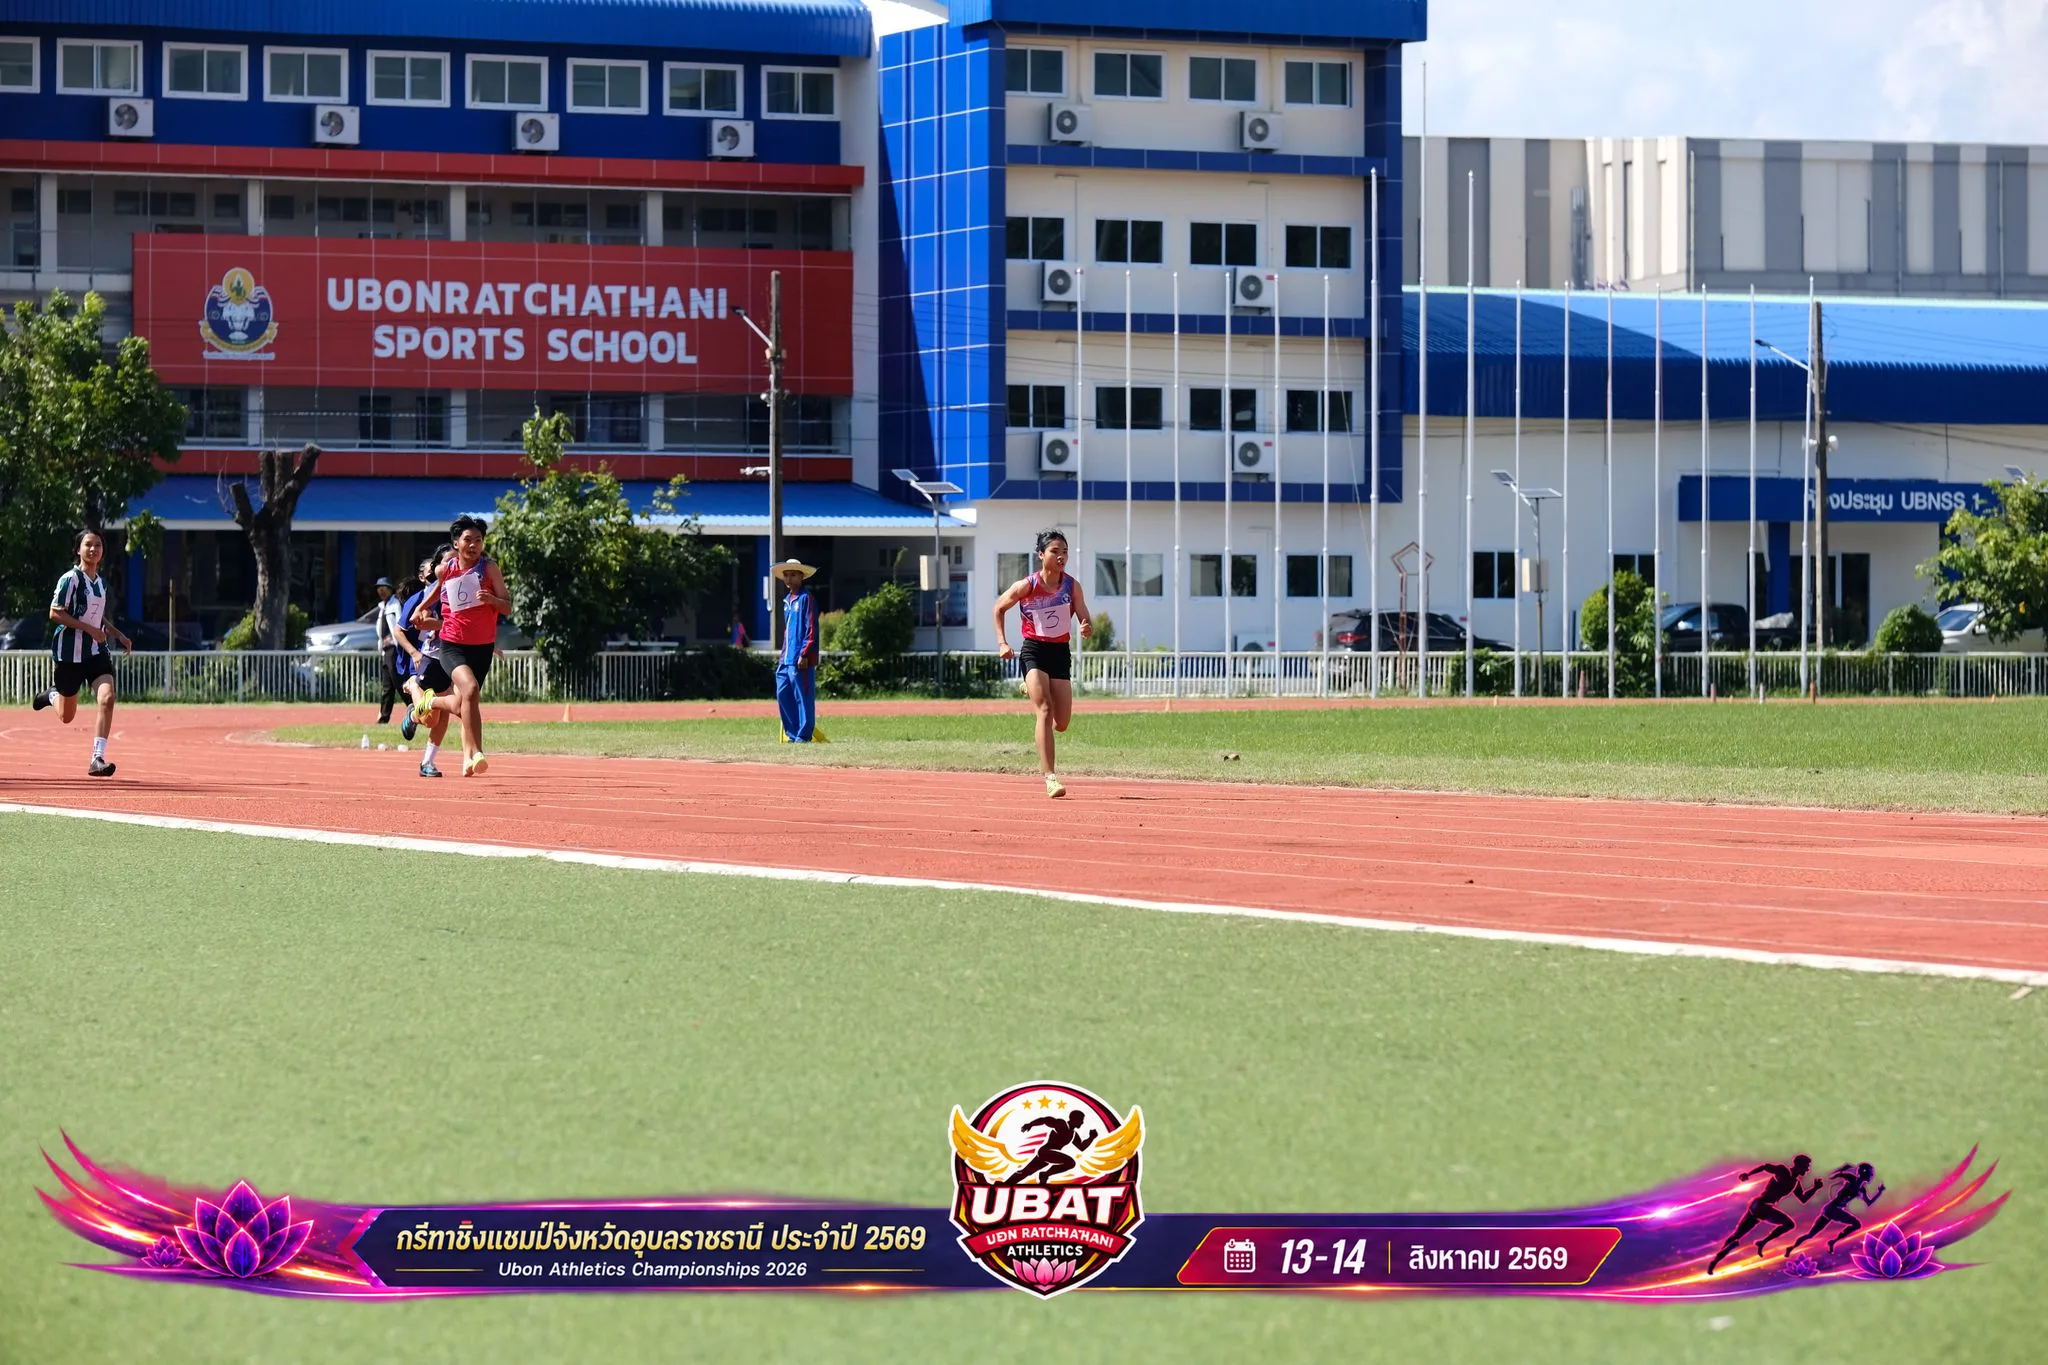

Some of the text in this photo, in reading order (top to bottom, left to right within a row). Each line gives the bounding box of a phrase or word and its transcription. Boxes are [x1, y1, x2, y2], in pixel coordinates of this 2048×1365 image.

[327, 277, 728, 319] UBONRATCHATHANI
[373, 324, 698, 364] SPORTS SCHOOL
[1901, 491, 1966, 511] UBNSS
[457, 581, 468, 602] 6
[91, 603, 100, 621] 7
[1044, 610, 1060, 629] 3
